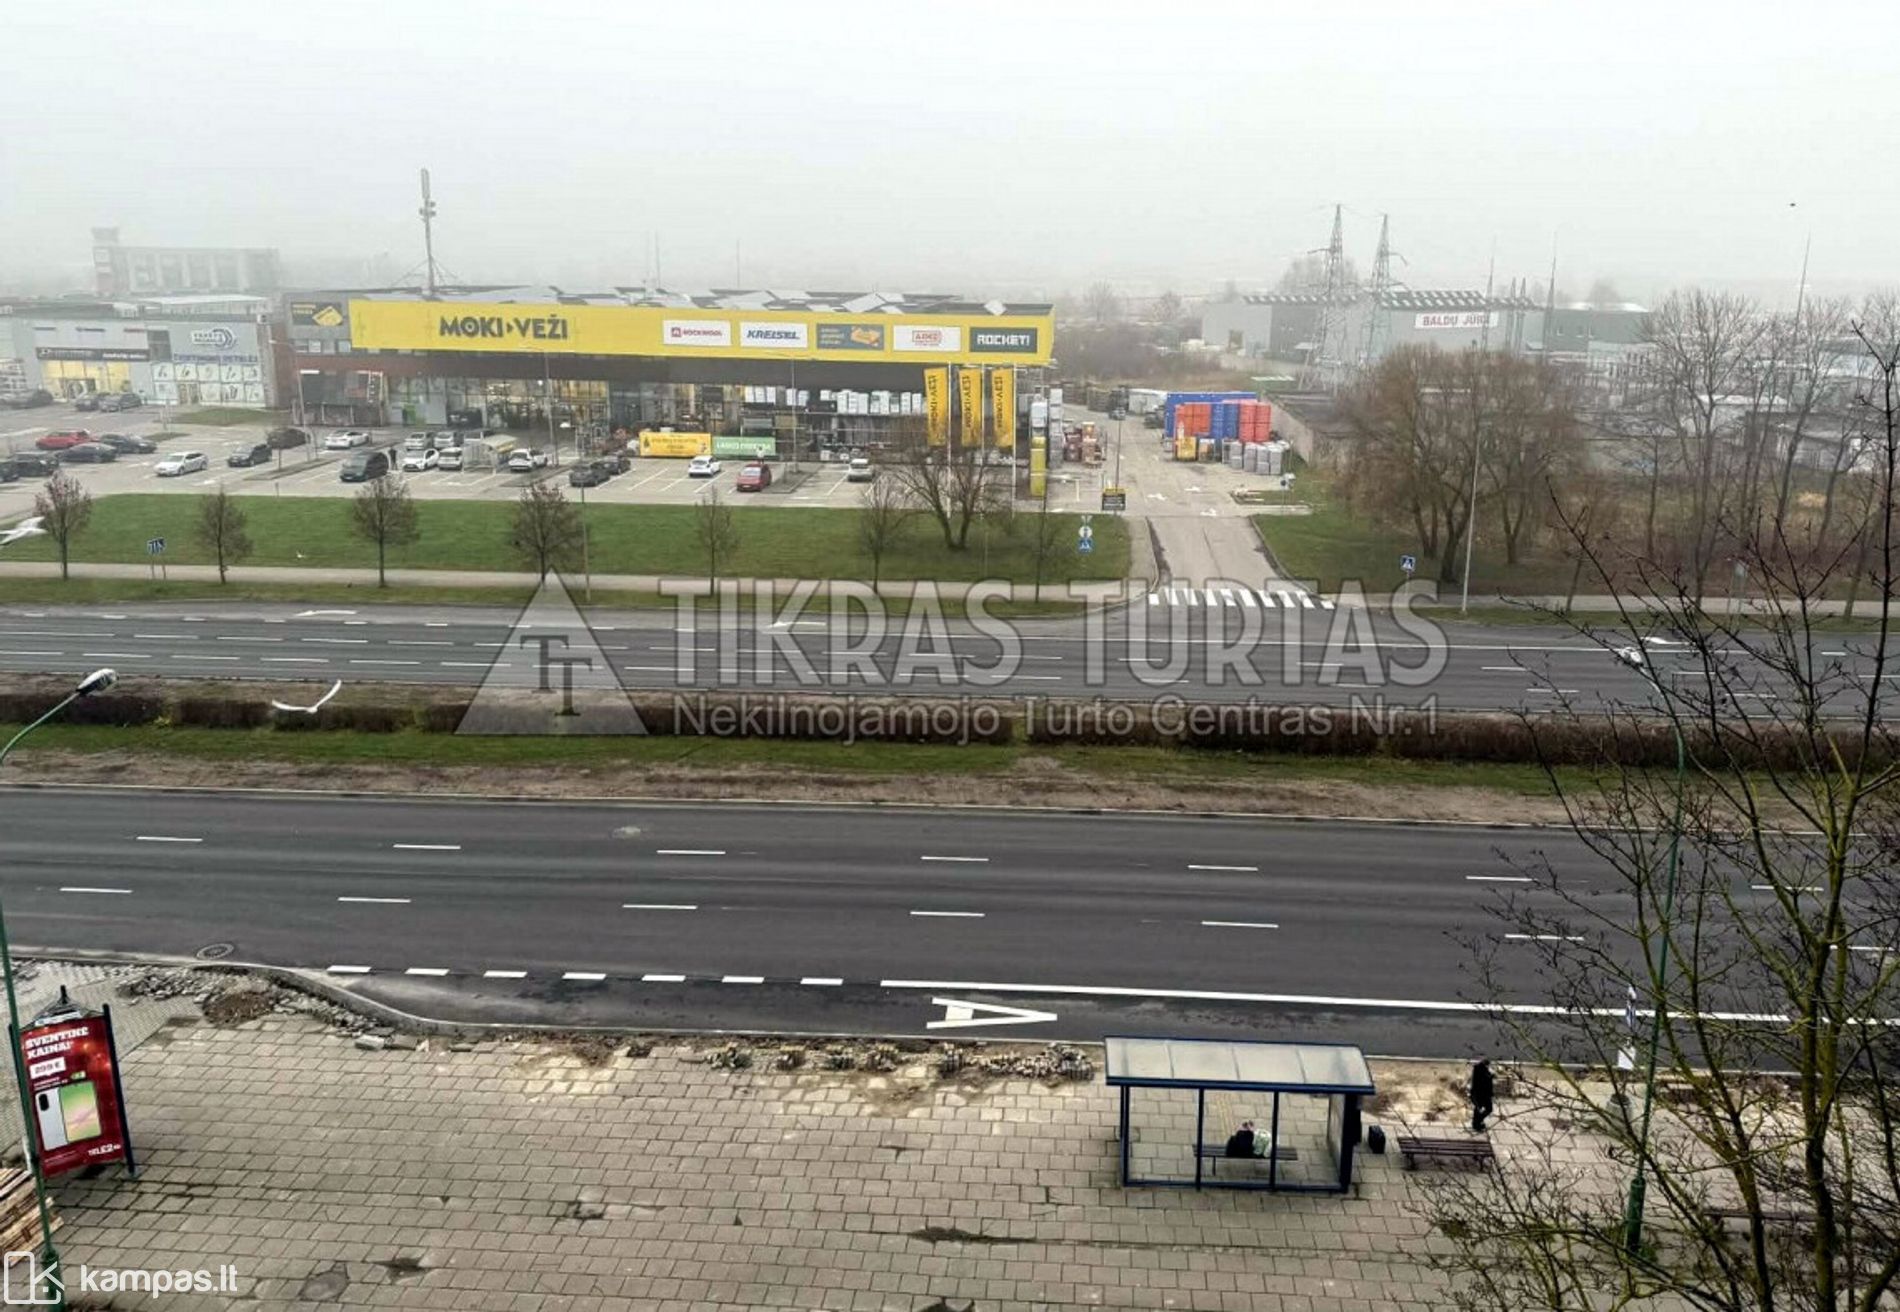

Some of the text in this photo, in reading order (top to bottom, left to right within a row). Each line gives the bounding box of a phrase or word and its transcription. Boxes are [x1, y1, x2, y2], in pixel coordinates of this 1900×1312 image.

[440, 314, 568, 340] MOKI VEŽI
[976, 333, 1030, 346] ROCKET!
